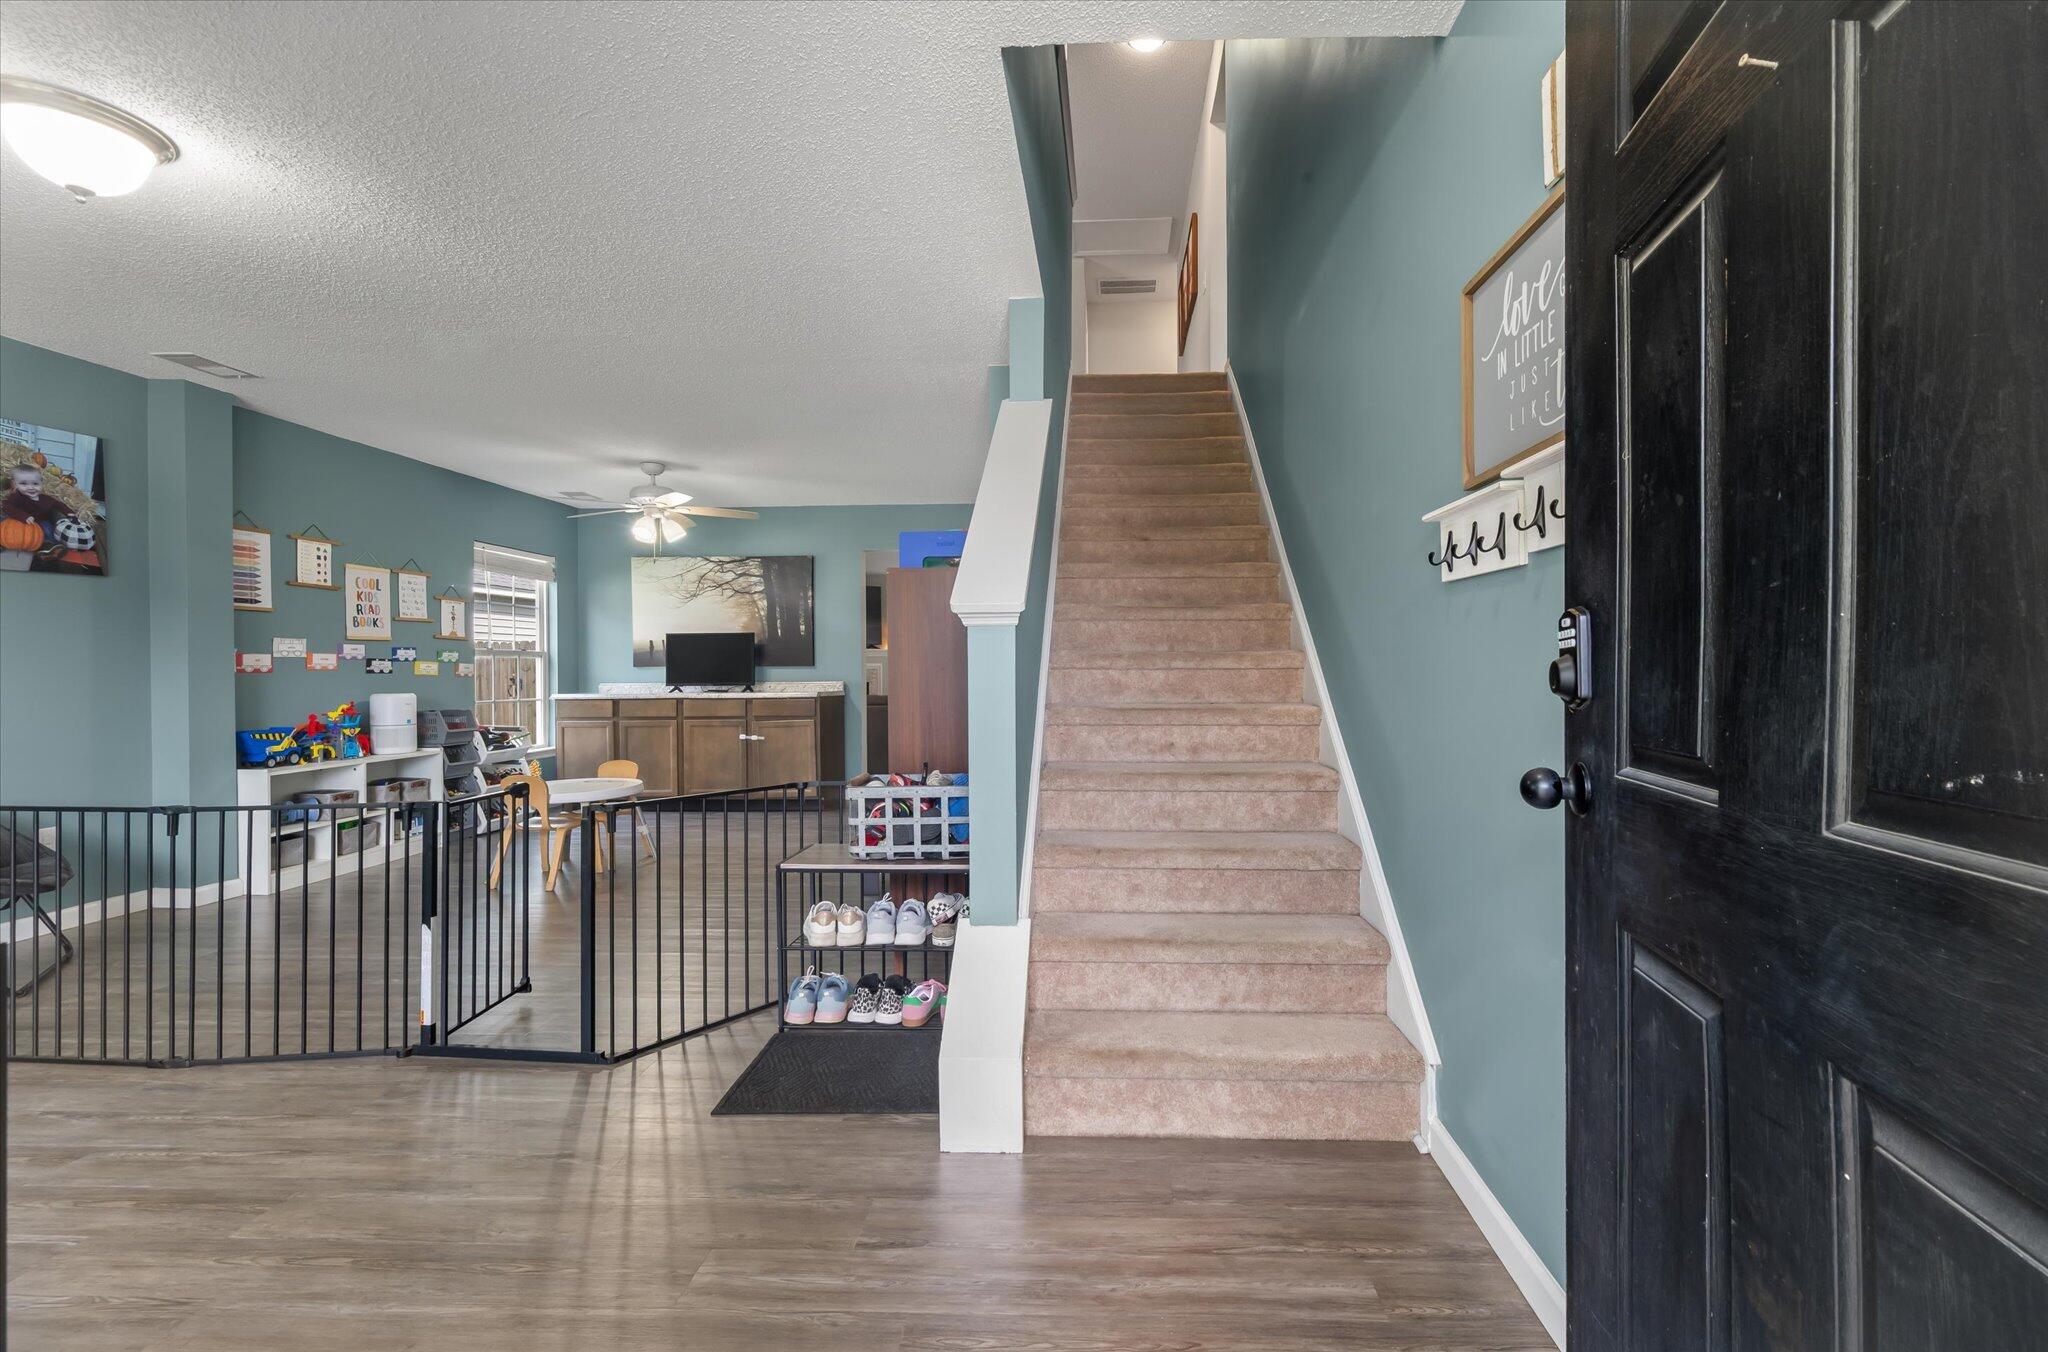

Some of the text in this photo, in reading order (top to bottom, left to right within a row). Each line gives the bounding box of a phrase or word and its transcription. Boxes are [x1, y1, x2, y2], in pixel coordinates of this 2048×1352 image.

[1482, 258, 1562, 361] love
[1497, 348, 1508, 381] IN
[1514, 309, 1556, 368] LITTLE
[1509, 356, 1550, 400] JUST
[1510, 390, 1551, 432] LIKE
[355, 576, 382, 592] COOL
[356, 590, 381, 604] KIDS
[352, 616, 385, 629] BOOKS
[356, 603, 381, 616] READ
